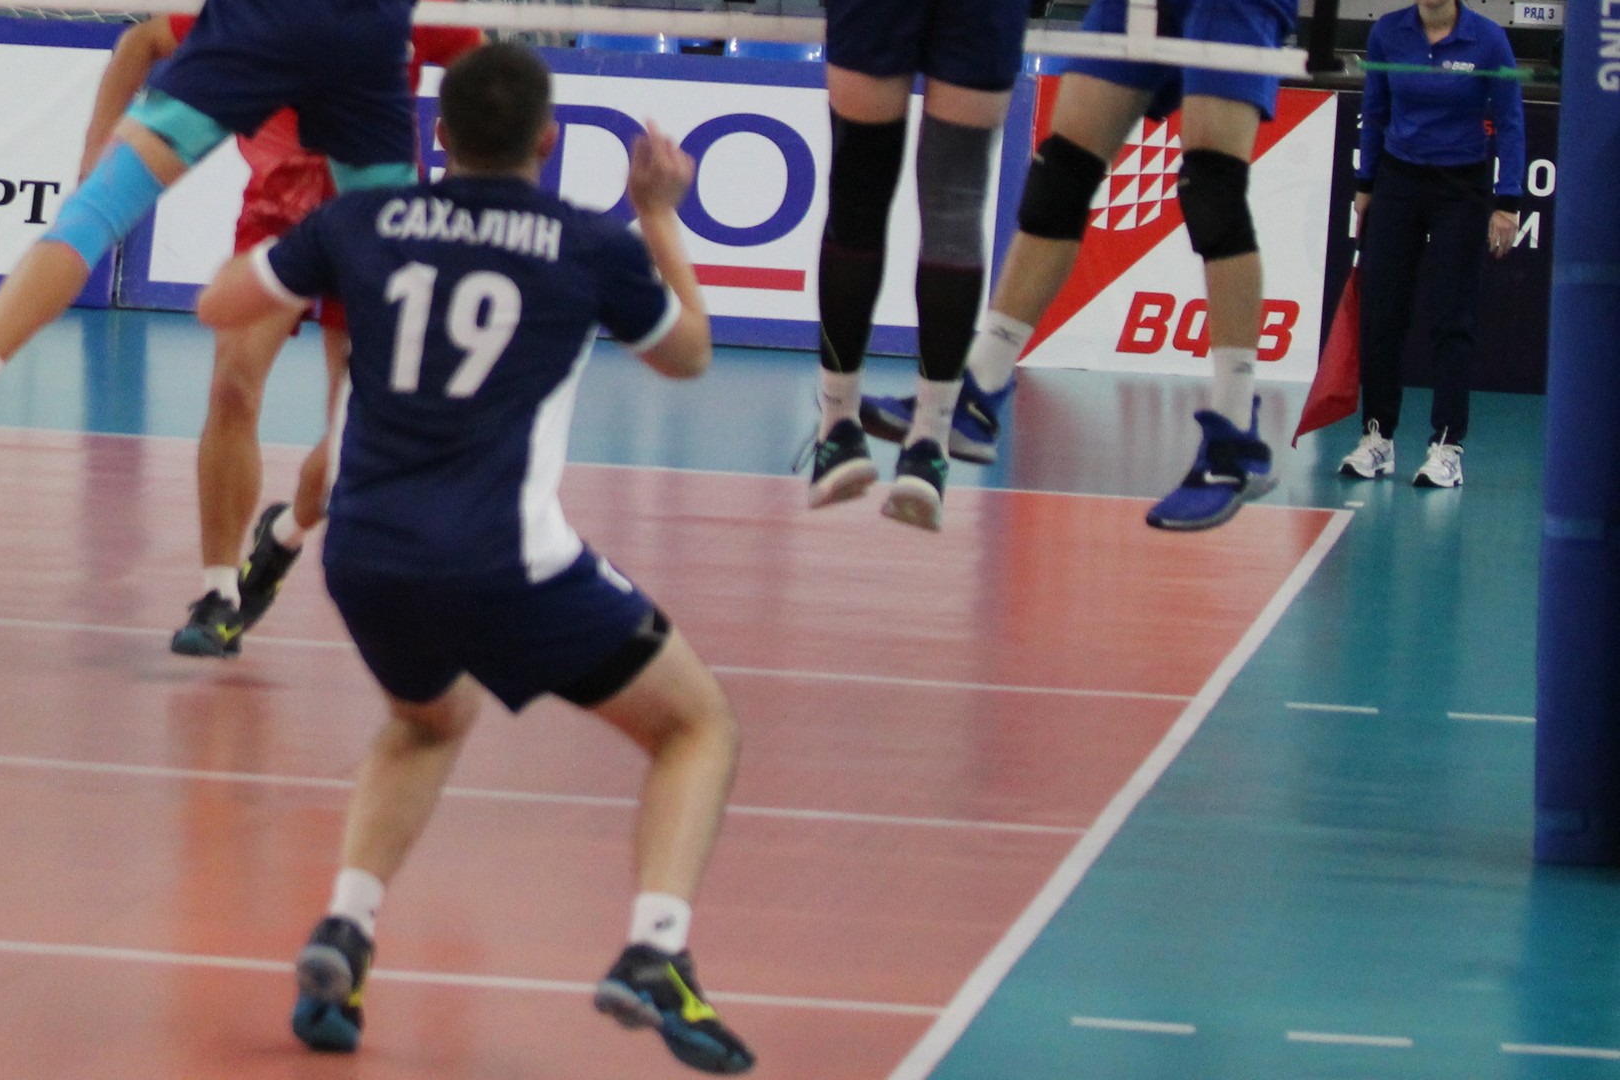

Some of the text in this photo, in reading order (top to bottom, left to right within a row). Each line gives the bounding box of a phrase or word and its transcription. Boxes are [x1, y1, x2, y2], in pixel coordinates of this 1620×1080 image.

[1524, 7, 1554, 20] РЯД 3
[376, 197, 562, 262] САХАЛИН
[384, 260, 522, 398] 19
